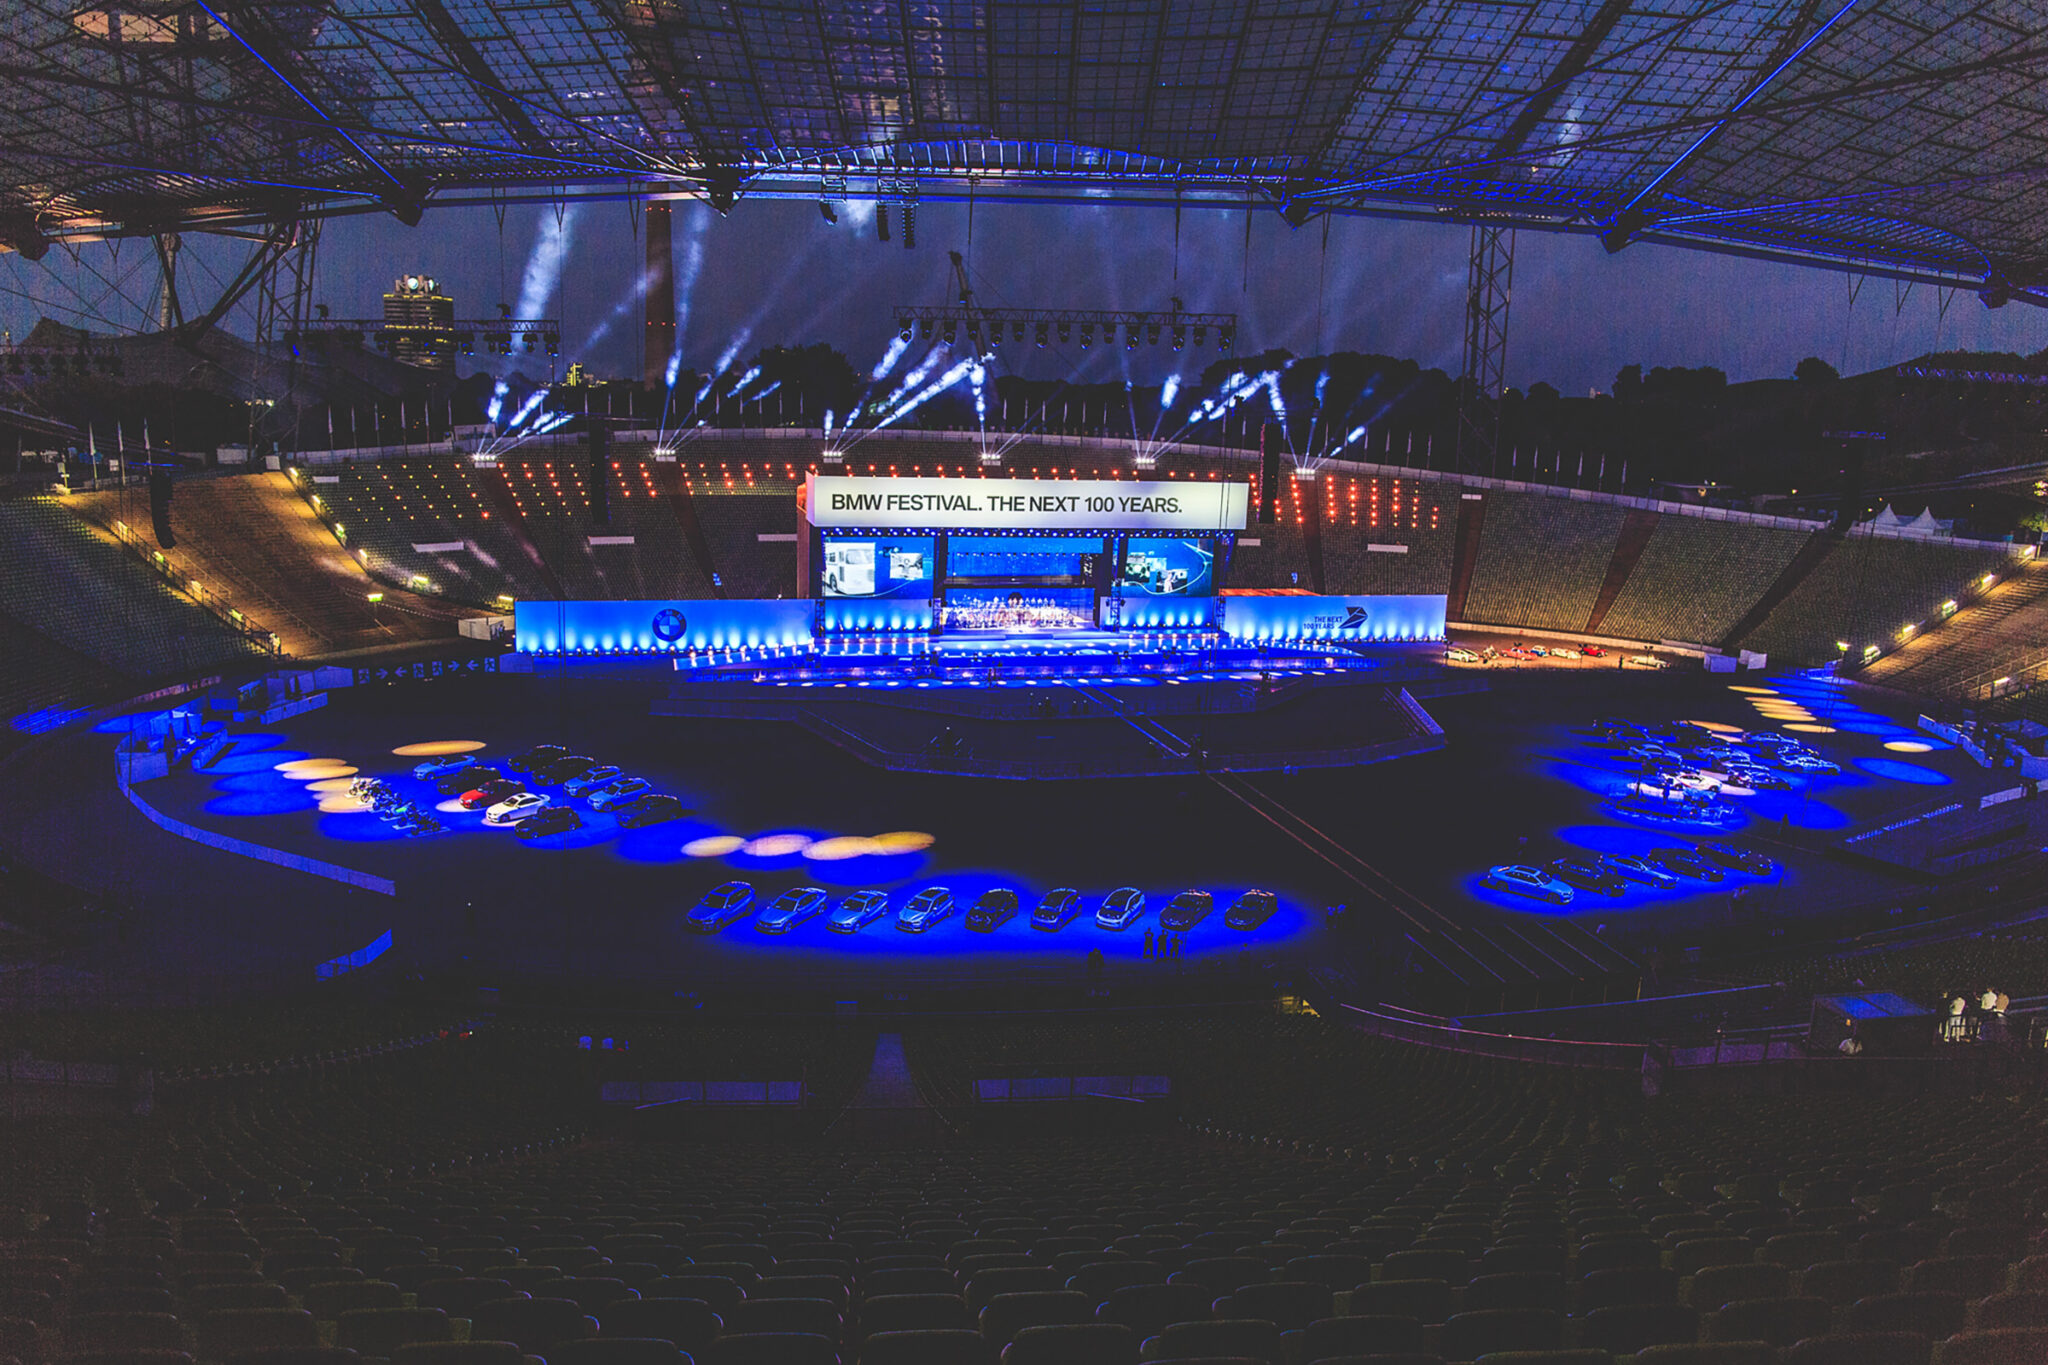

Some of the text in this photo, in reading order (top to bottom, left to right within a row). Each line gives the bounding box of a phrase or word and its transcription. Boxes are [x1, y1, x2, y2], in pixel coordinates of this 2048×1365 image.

[832, 494, 1182, 513] BMW FESTIVAL. THE NEXT 100 YEARS.
[1314, 615, 1343, 623] THE NEXT
[1303, 622, 1335, 630] 100 YEARS
